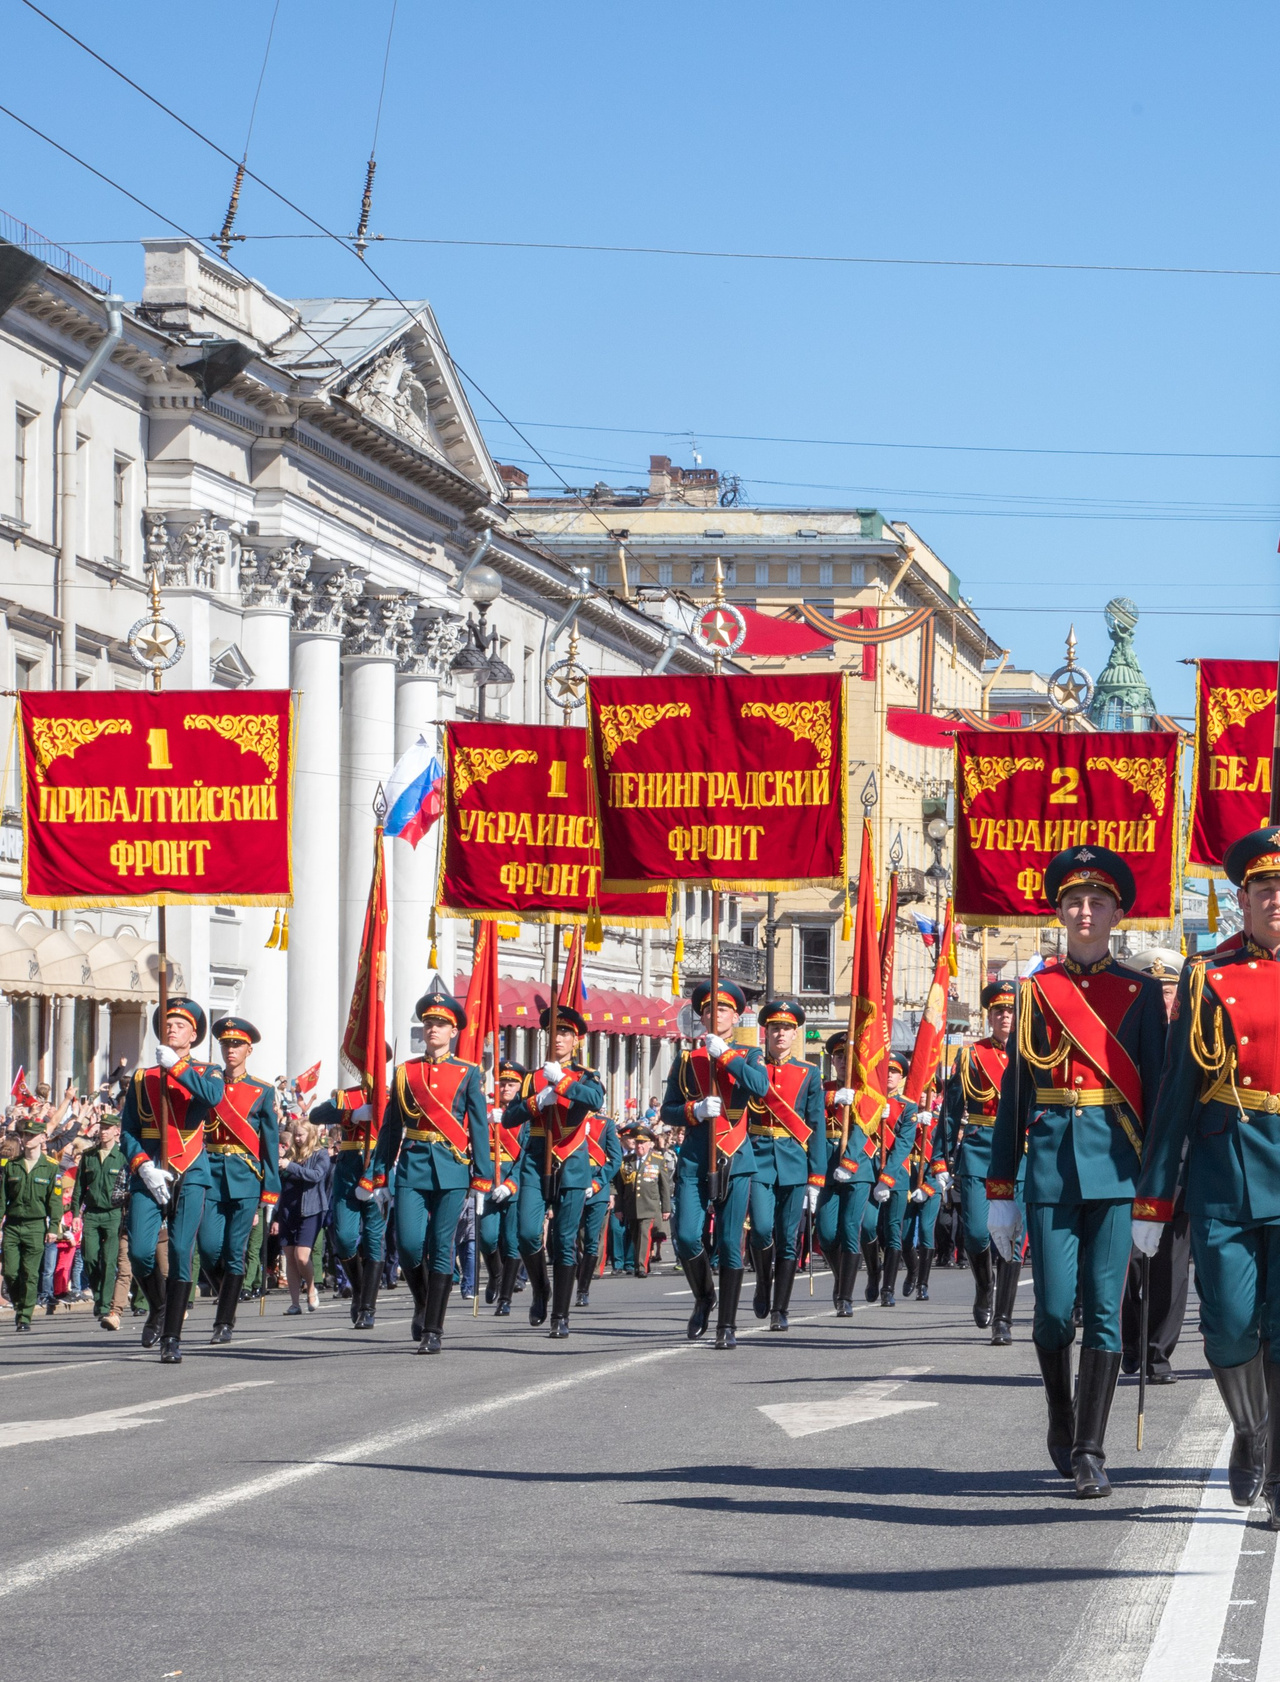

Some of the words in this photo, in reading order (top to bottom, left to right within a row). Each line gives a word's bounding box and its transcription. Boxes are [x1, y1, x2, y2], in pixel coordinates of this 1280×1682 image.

[146, 728, 173, 770] 1
[547, 760, 569, 798] 1
[608, 768, 830, 809] ЛЕНИНГРАДСКИЙ
[1049, 767, 1080, 804] 2
[38, 777, 278, 823] ПРИБАЛТИЙСКИЙ
[458, 809, 601, 849] УКРАИНС
[668, 825, 765, 861] ФРОНТ
[969, 813, 1157, 853] УКРАИНСКИЙ
[109, 839, 211, 876] ФРОНТ
[500, 861, 602, 898] ФРОНТ
